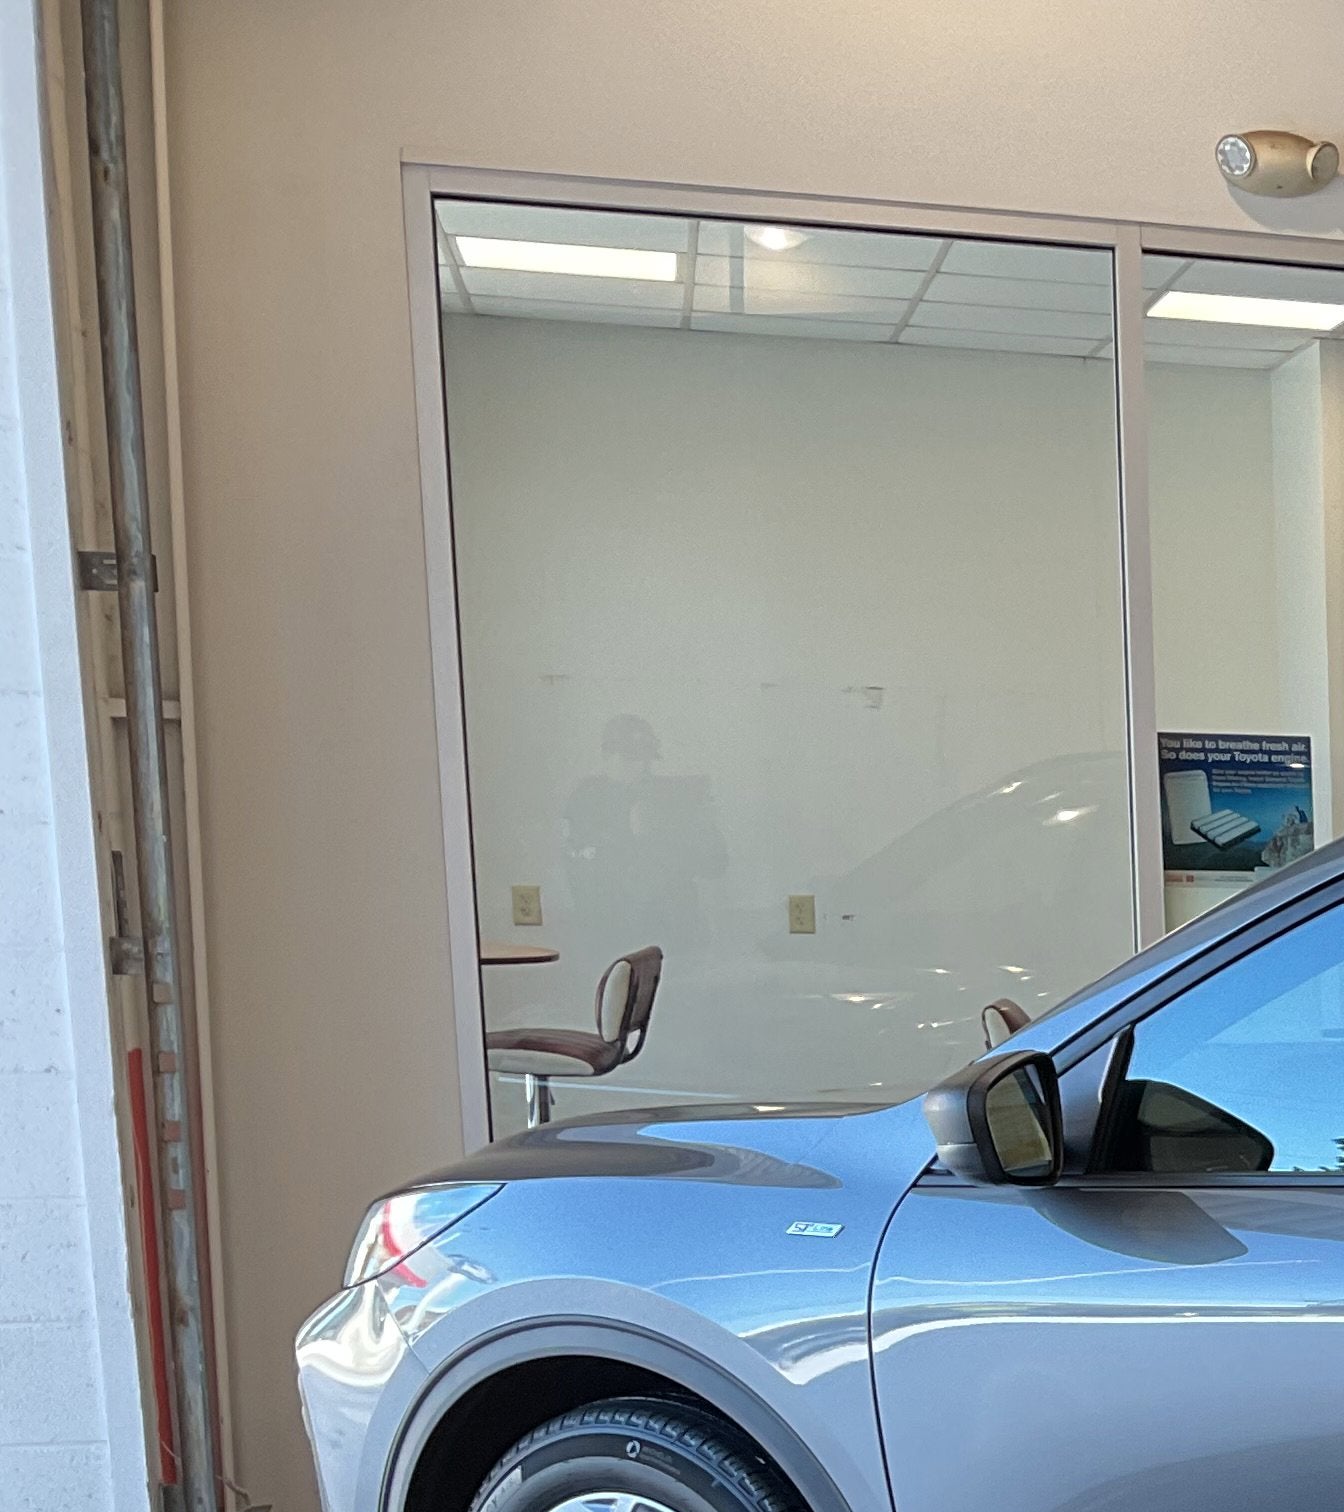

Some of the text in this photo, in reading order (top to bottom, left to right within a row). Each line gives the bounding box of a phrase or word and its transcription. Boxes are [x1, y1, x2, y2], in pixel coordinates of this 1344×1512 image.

[1160, 738, 1181, 749] You
[1183, 738, 1203, 749] like
[1205, 740, 1217, 749] to
[1218, 739, 1260, 751] breathe
[1262, 741, 1289, 752] fresh
[1160, 750, 1177, 760] So
[1178, 750, 1206, 761] does
[1207, 752, 1232, 763] your
[1233, 751, 1269, 763] Toyota
